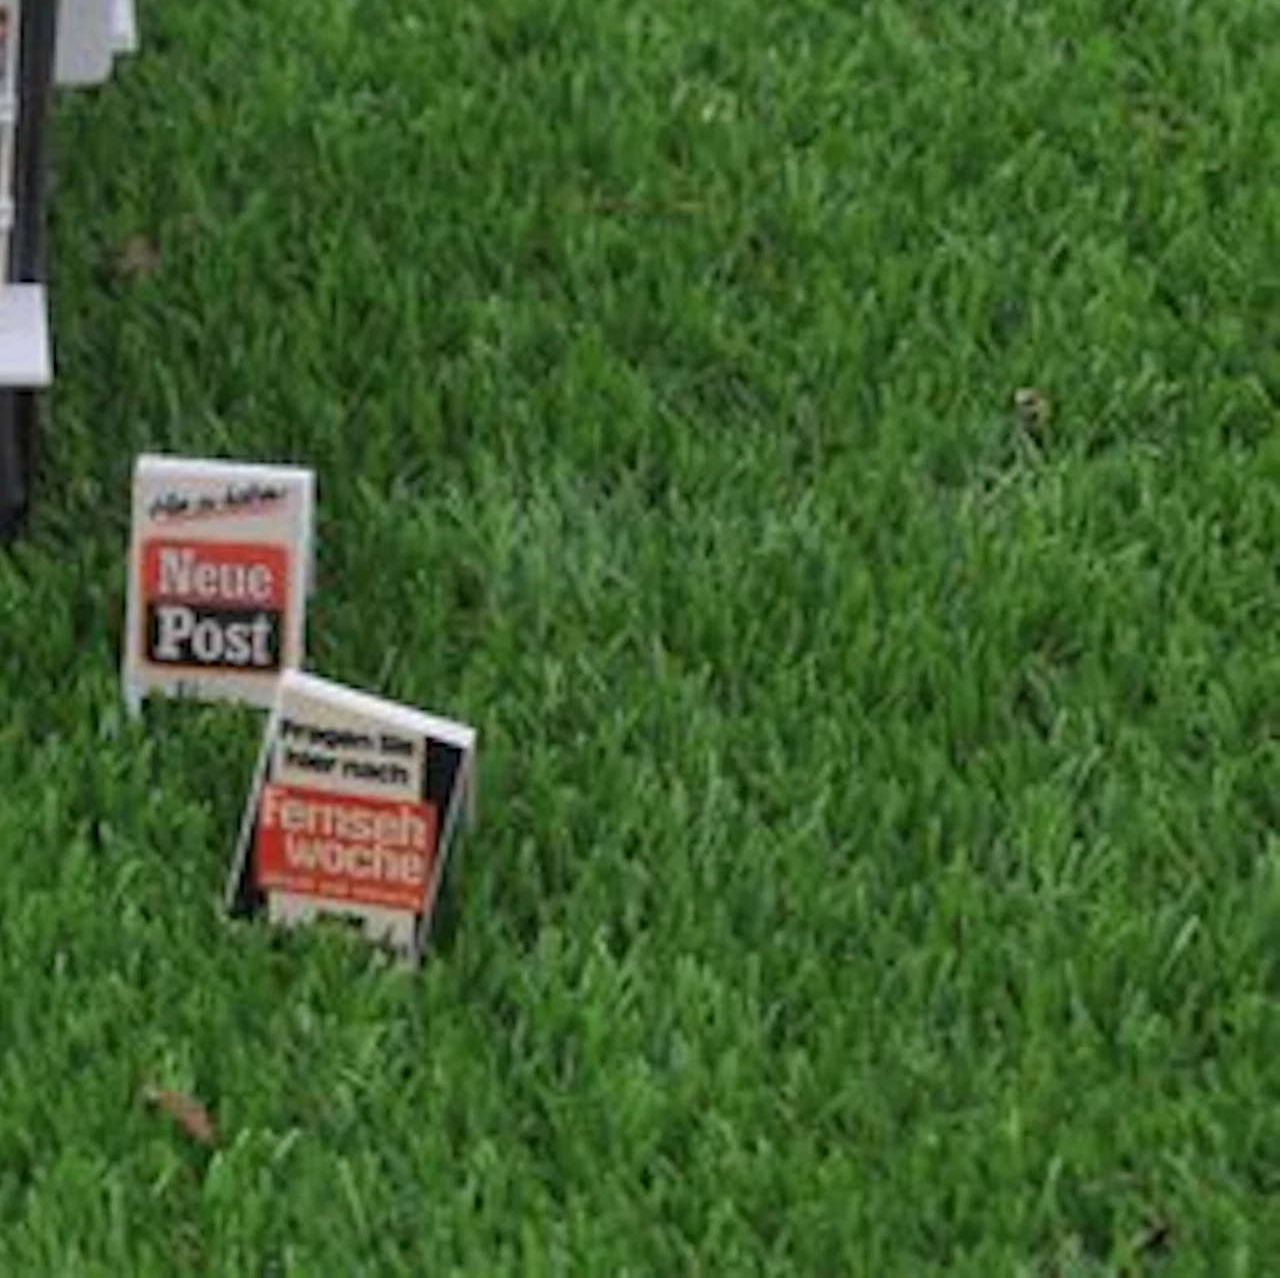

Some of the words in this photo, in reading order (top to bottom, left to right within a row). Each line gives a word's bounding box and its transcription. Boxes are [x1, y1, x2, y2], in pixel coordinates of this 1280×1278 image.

[157, 545, 275, 599] Neue
[153, 604, 274, 665] Post
[281, 718, 371, 750] Fragen
[342, 759, 409, 784] nach
[262, 787, 428, 848] Fernseh
[284, 829, 425, 885] woche
